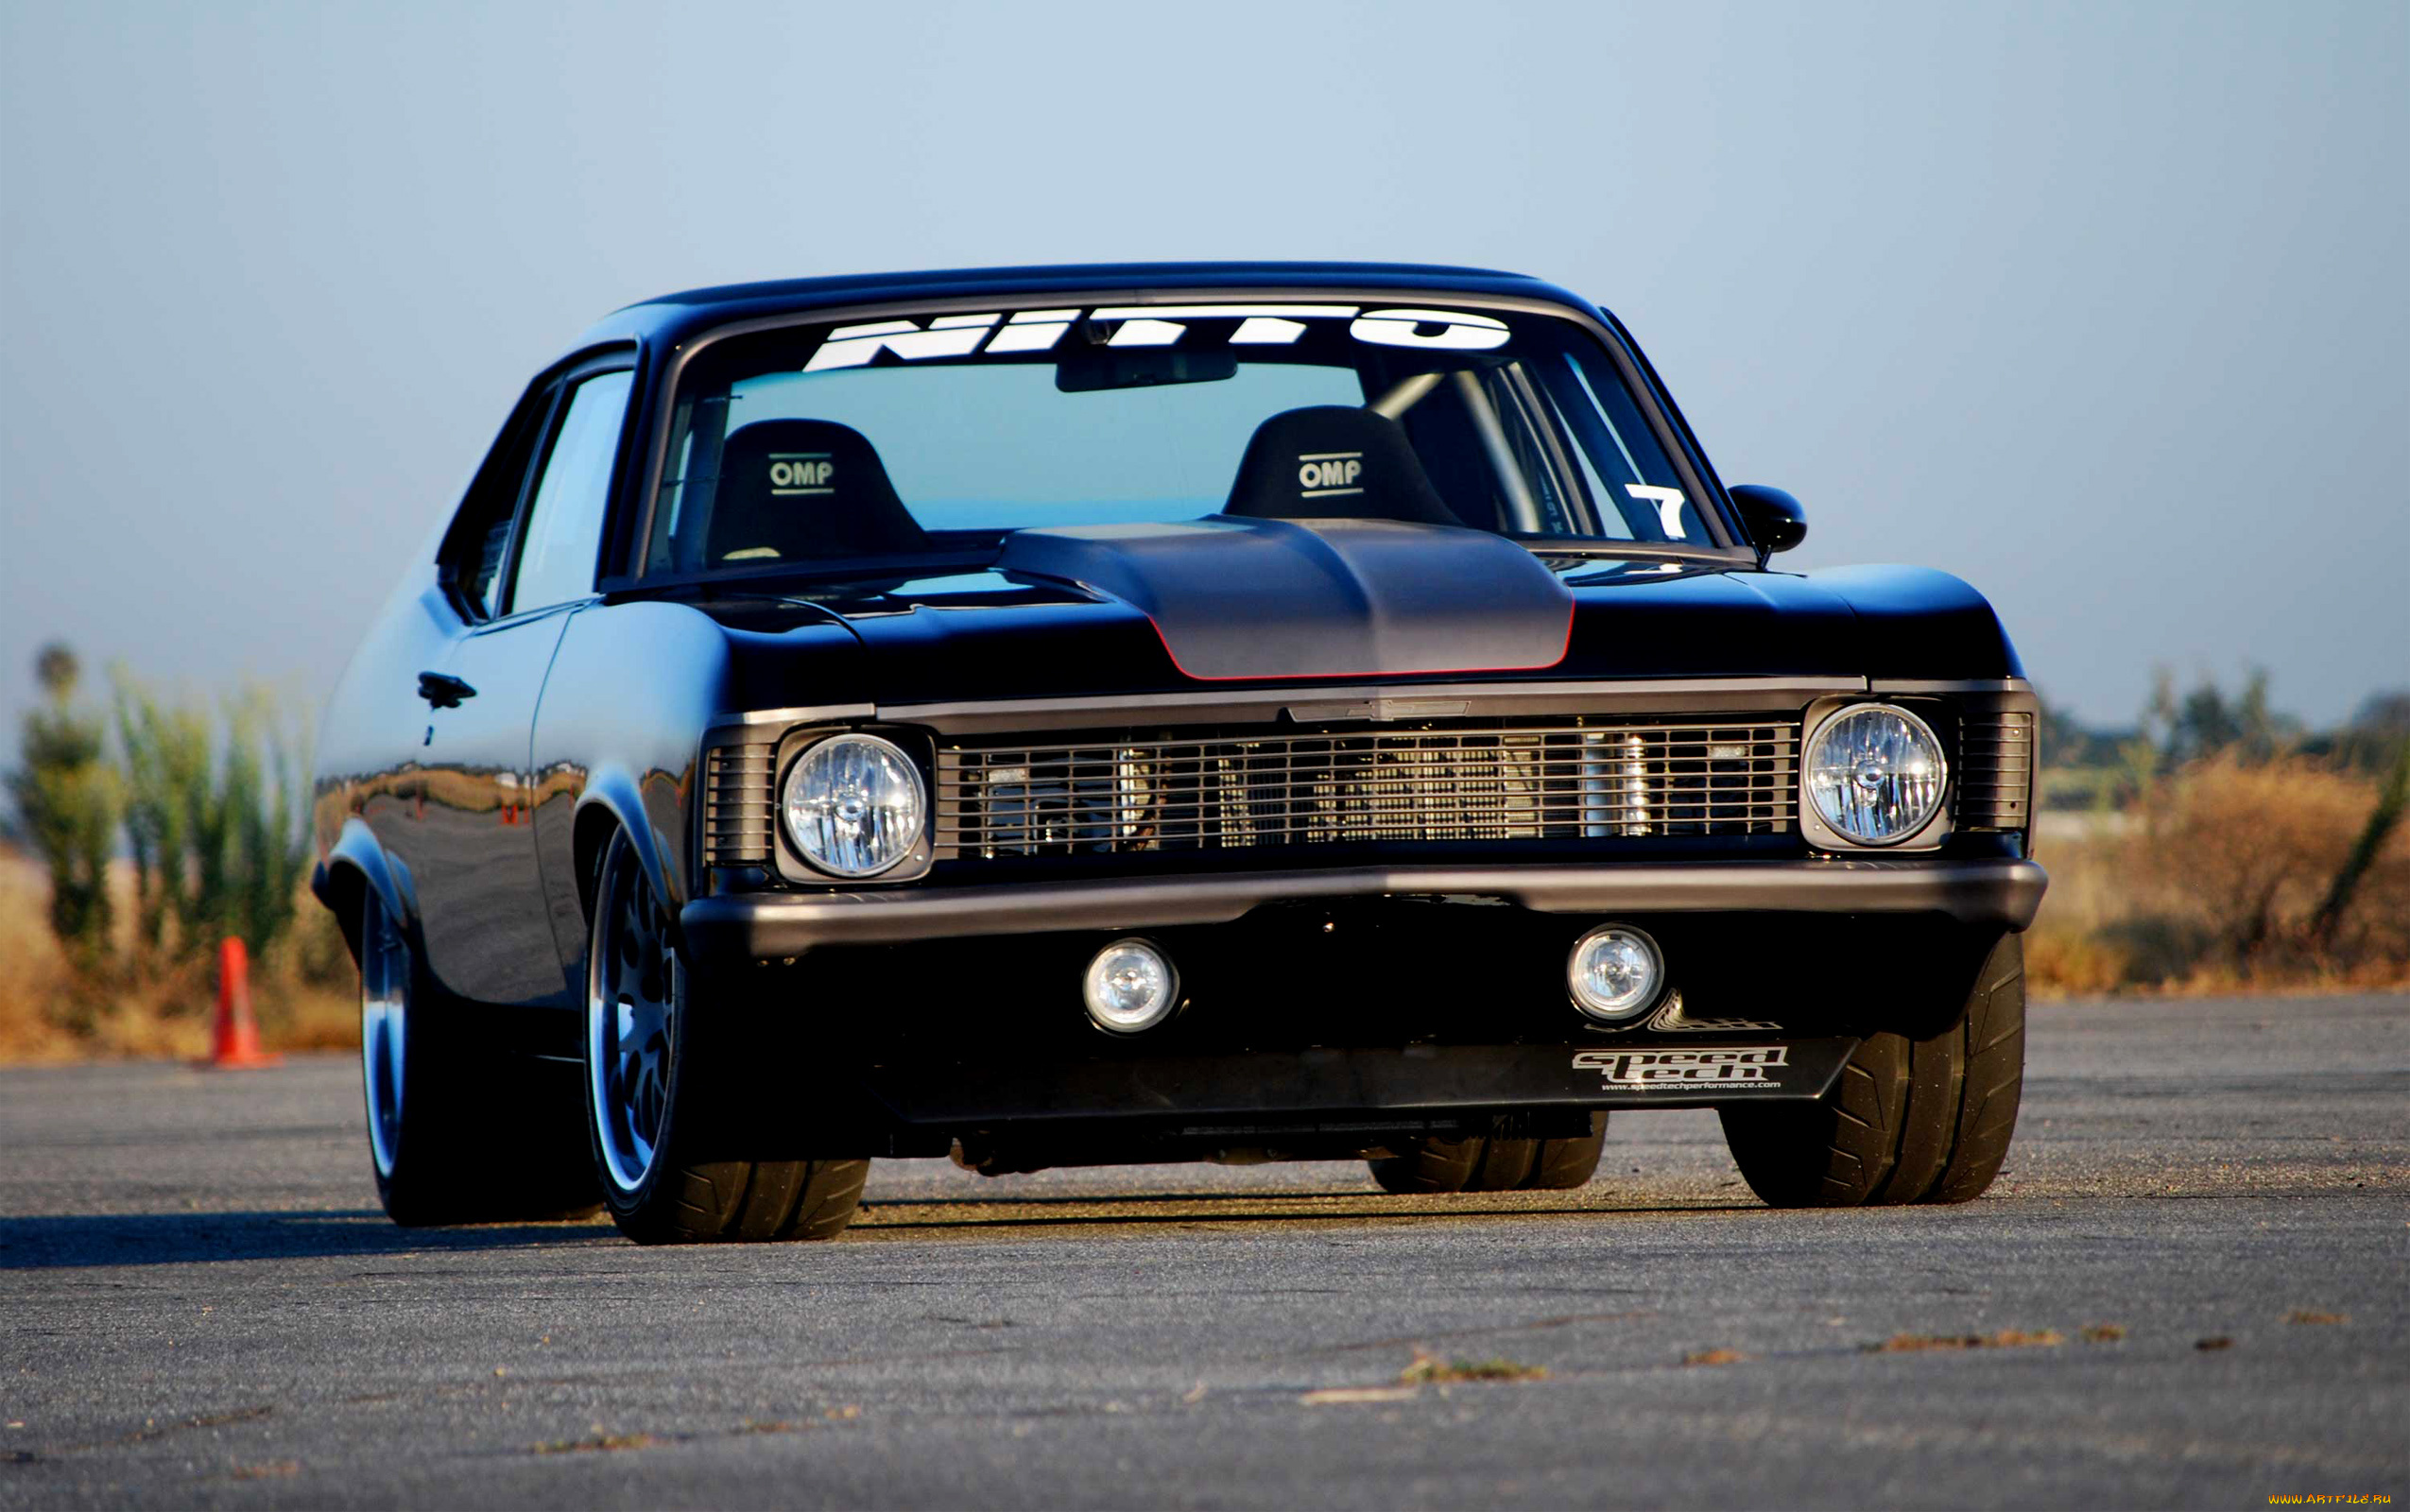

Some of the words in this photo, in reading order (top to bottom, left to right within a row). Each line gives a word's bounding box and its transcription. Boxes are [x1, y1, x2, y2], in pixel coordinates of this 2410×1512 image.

[802, 305, 1511, 372] NITTO
[770, 461, 834, 487] OMP
[1300, 459, 1362, 489] OMP
[1624, 483, 1686, 540] 7
[1602, 1082, 1781, 1091] www.speedtechperformance.com
